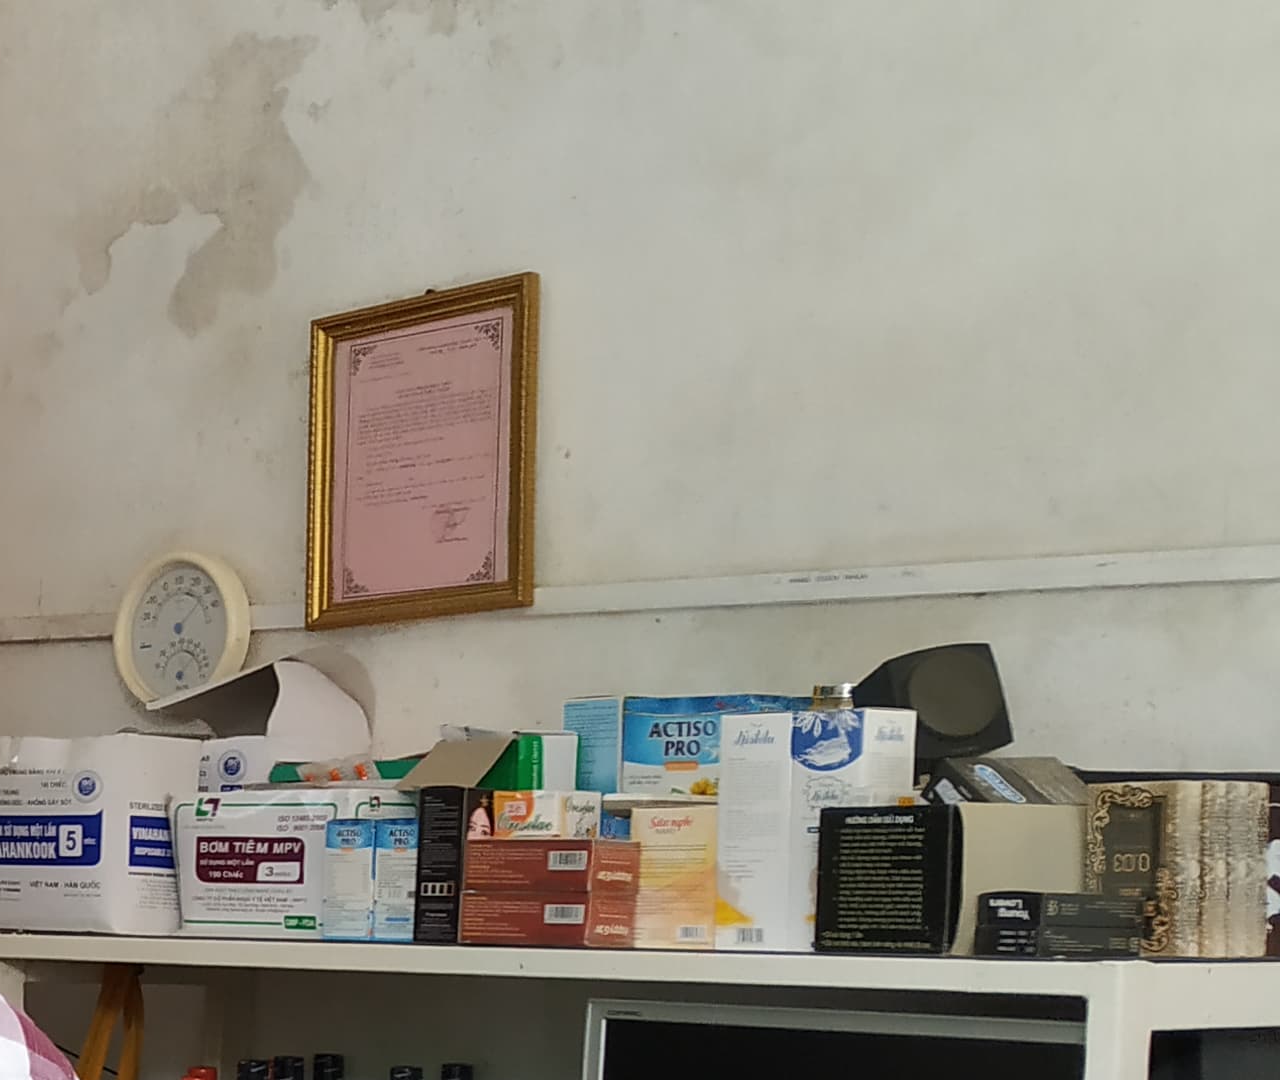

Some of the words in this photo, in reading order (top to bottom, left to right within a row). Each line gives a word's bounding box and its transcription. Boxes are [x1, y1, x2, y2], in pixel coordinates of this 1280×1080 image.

[649, 720, 716, 738] ACTISO
[664, 740, 700, 756] PRO
[65, 831, 77, 851] 5
[200, 840, 229, 854] BƠM
[232, 839, 269, 854] TIÊM
[272, 842, 302, 854] MPV
[265, 867, 274, 877] 3
